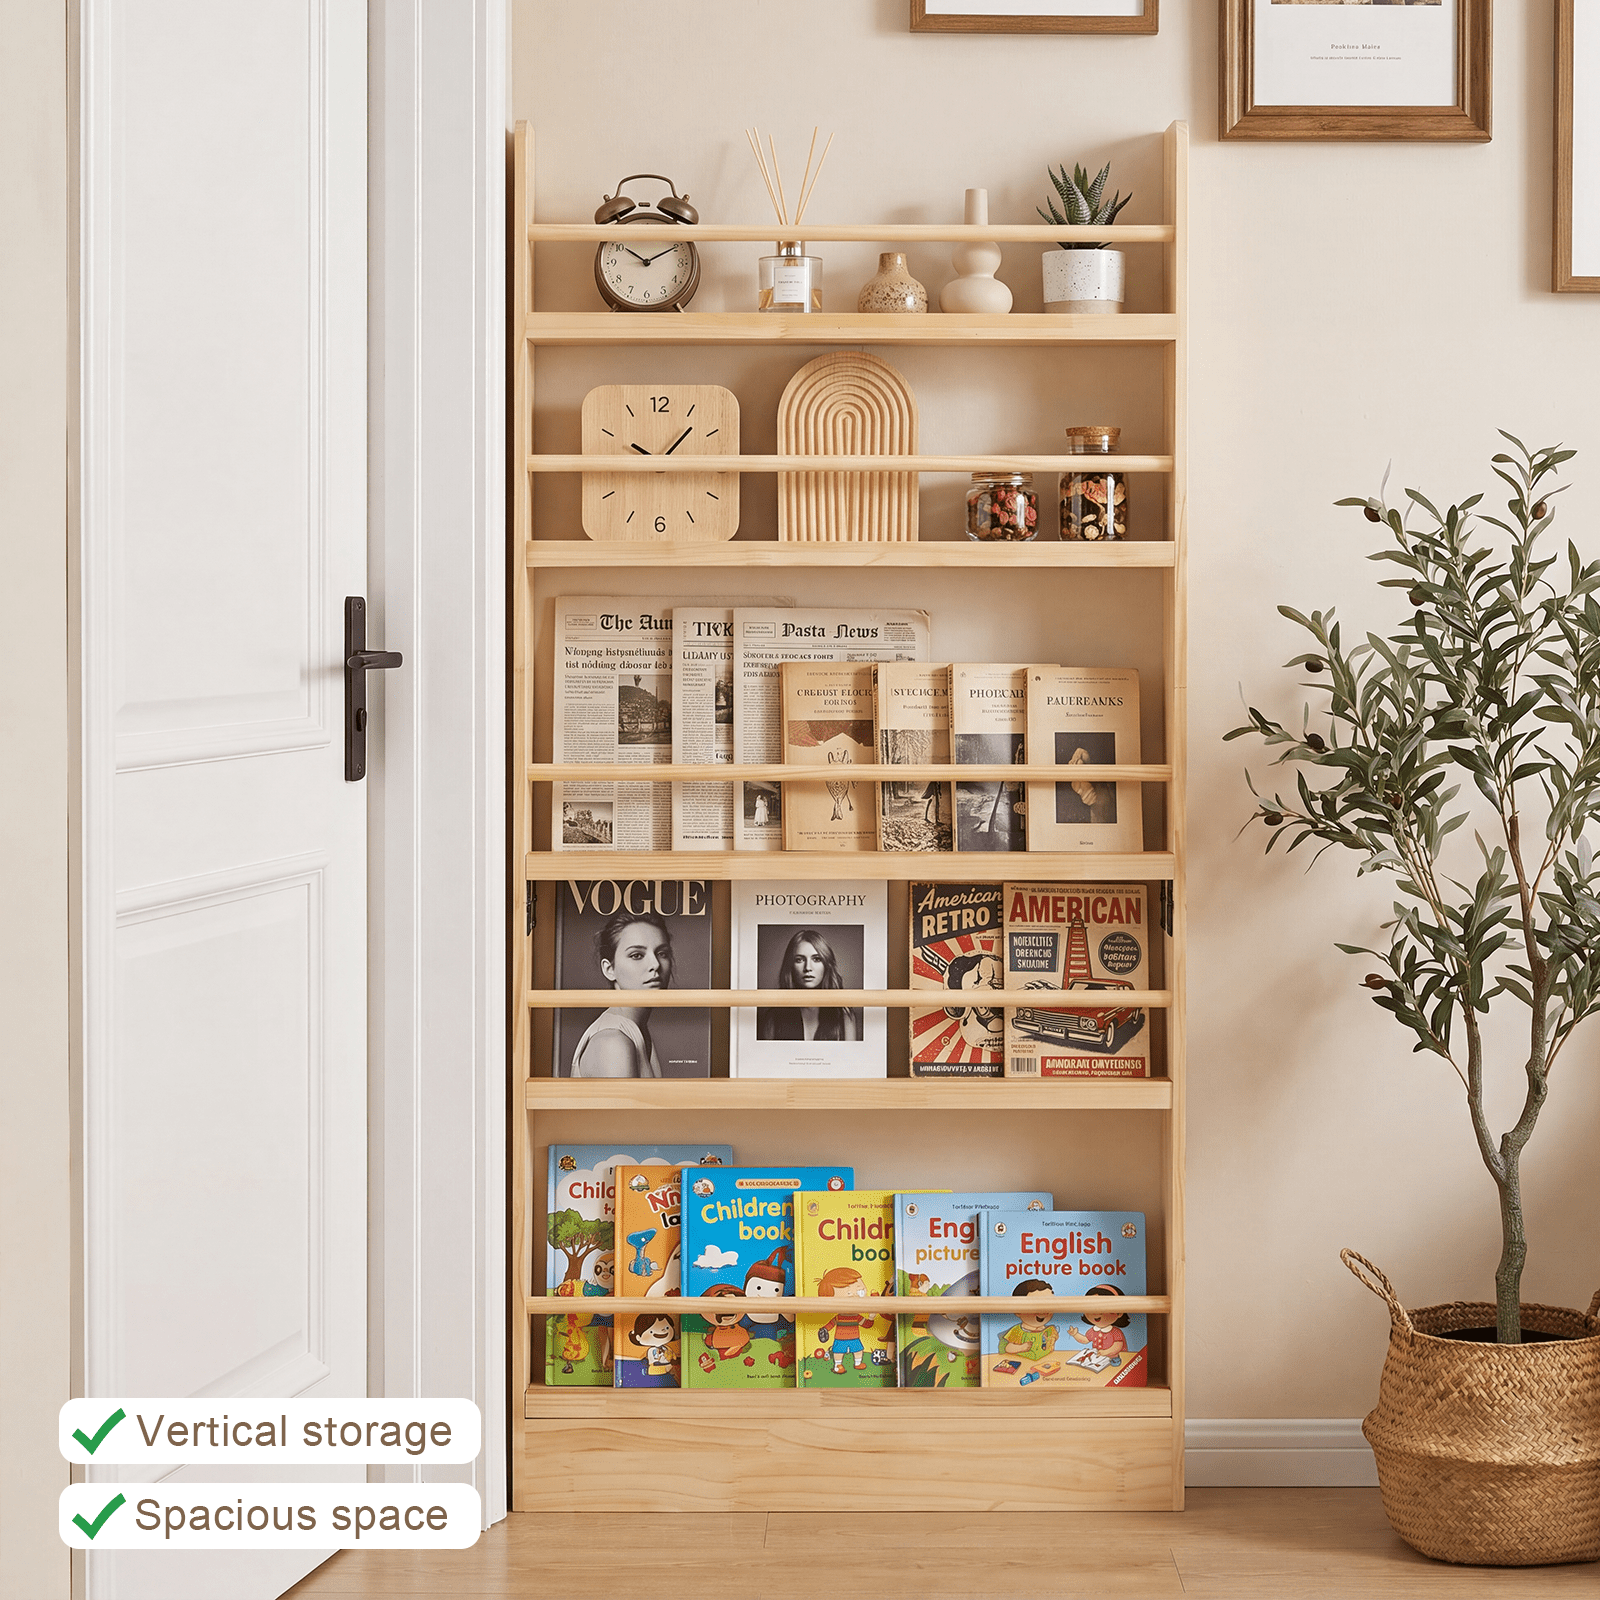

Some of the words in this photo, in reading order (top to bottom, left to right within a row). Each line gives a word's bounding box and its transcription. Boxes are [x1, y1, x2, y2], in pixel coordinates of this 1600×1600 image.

[615, 243, 625, 253] 10
[610, 258, 617, 268] 9
[615, 273, 623, 284] 8
[671, 274, 679, 284] 4
[627, 285, 635, 295] 7
[643, 289, 651, 299] 6
[659, 285, 667, 296] 5
[649, 396, 670, 413] 12
[654, 516, 666, 533] 6
[599, 613, 634, 633] The
[781, 622, 826, 638] Pasta
[833, 623, 879, 639] News
[567, 879, 707, 917] VOGUE
[755, 894, 867, 906] PHOTOGRAPHY
[917, 887, 1003, 913] American
[1008, 891, 1142, 925] AMERICAN
[921, 906, 991, 939] RETRO
[701, 1196, 794, 1224] Children
[739, 1221, 794, 1241] book
[1020, 1231, 1112, 1260] English
[916, 1244, 980, 1265] picture
[1006, 1258, 1073, 1279] picture
[1079, 1258, 1127, 1276] book
